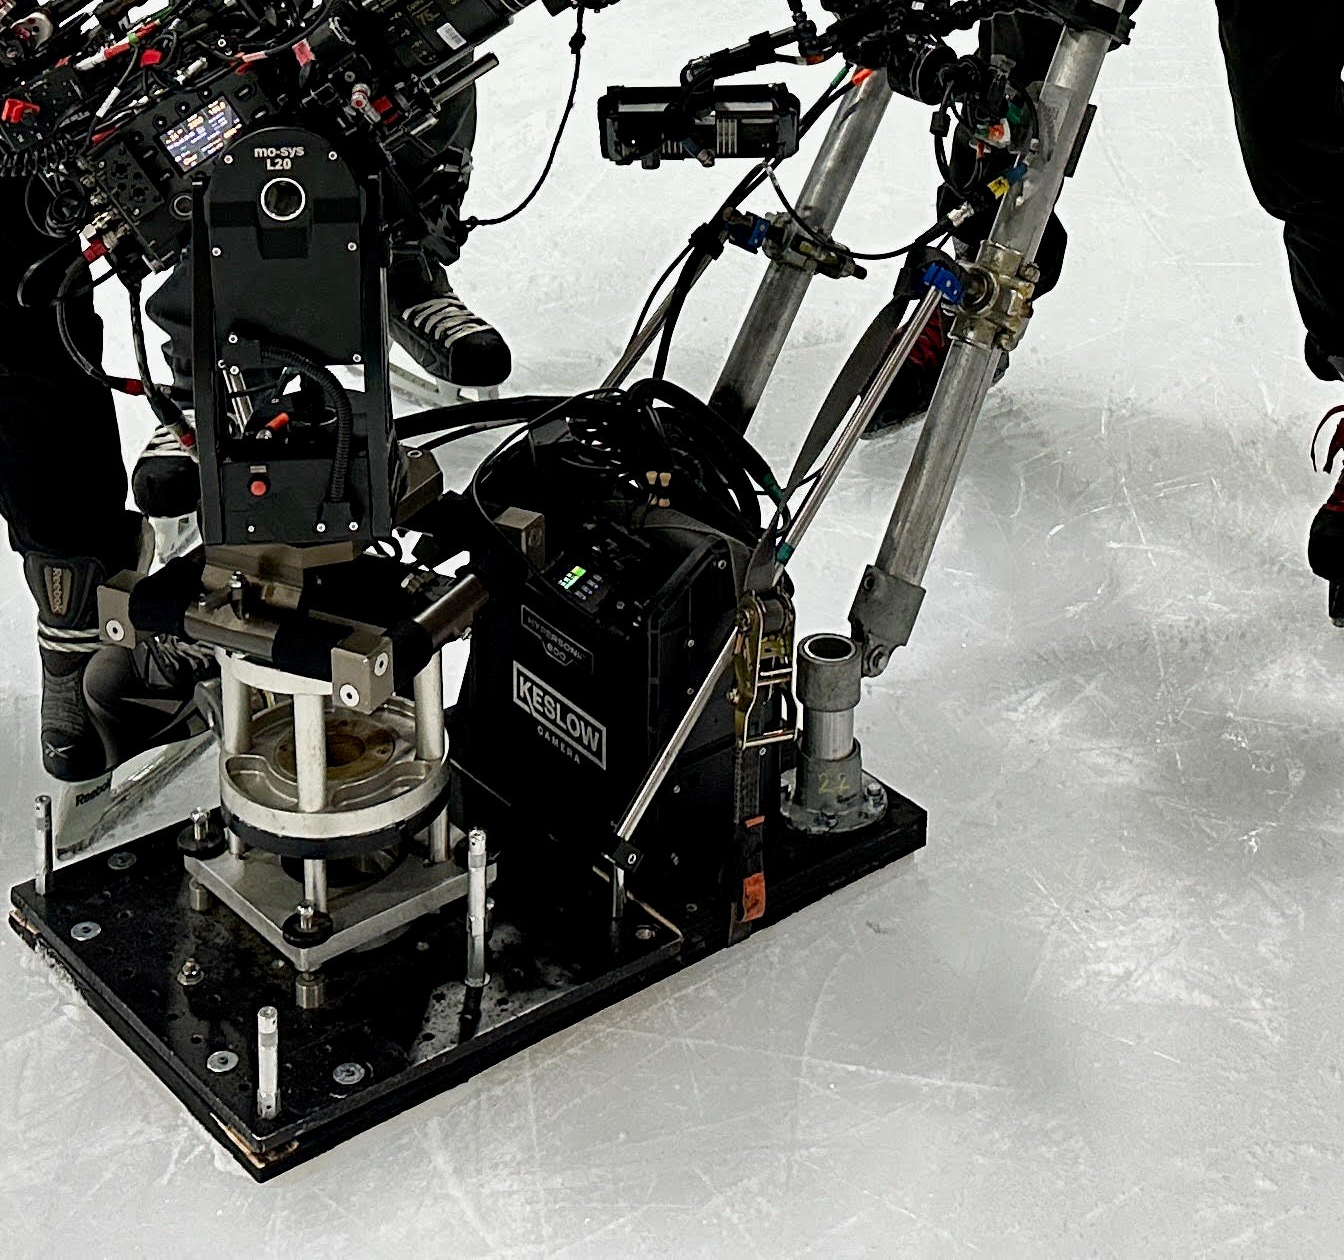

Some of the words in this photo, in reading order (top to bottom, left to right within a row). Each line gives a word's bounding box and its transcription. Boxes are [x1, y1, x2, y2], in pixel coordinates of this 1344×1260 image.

[253, 146, 305, 159] mo-sys
[266, 158, 292, 171] L20
[519, 675, 600, 752] KESLOW
[537, 725, 581, 765] CAMERA
